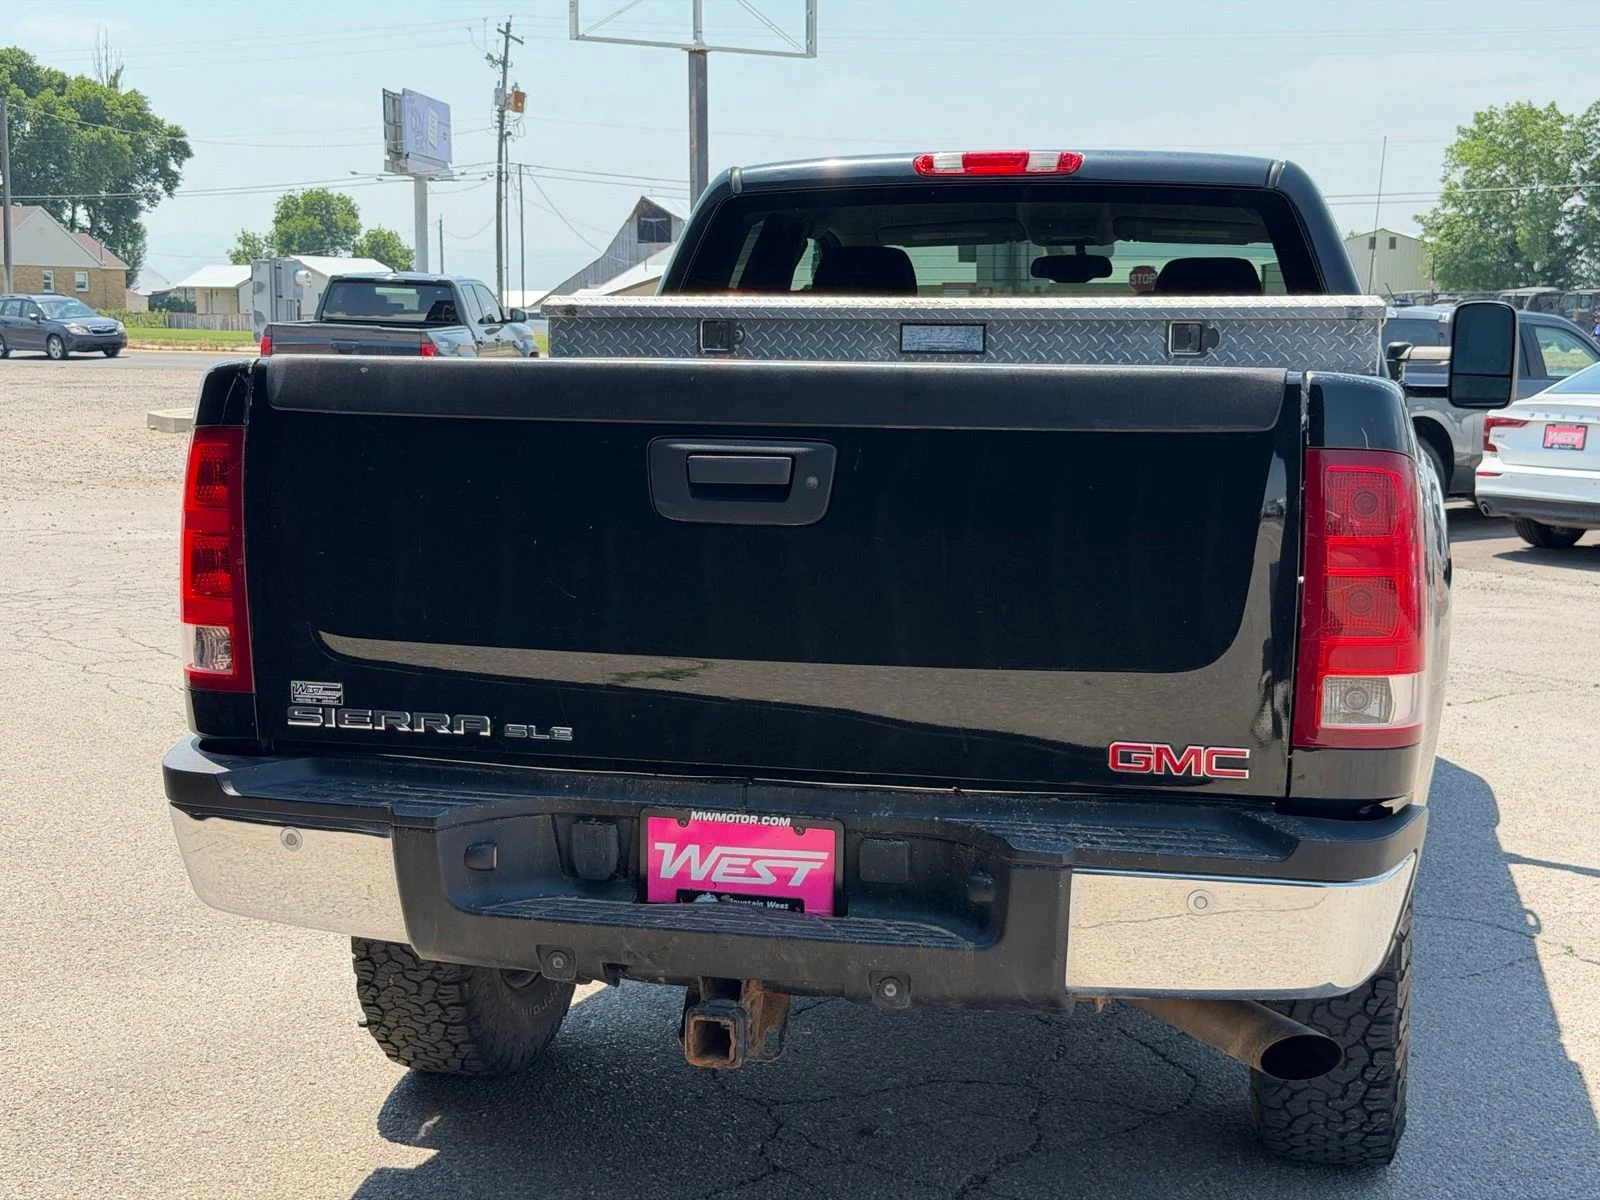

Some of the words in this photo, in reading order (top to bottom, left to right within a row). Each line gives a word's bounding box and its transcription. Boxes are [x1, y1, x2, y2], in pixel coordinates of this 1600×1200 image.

[1130, 273, 1156, 285] STOP
[287, 706, 491, 736] SIERRA
[504, 723, 573, 741] SLE
[1108, 741, 1250, 779] GMC
[690, 811, 791, 827] MWMOTOR.COM
[654, 842, 829, 887] WEST
[766, 900, 790, 909] West
